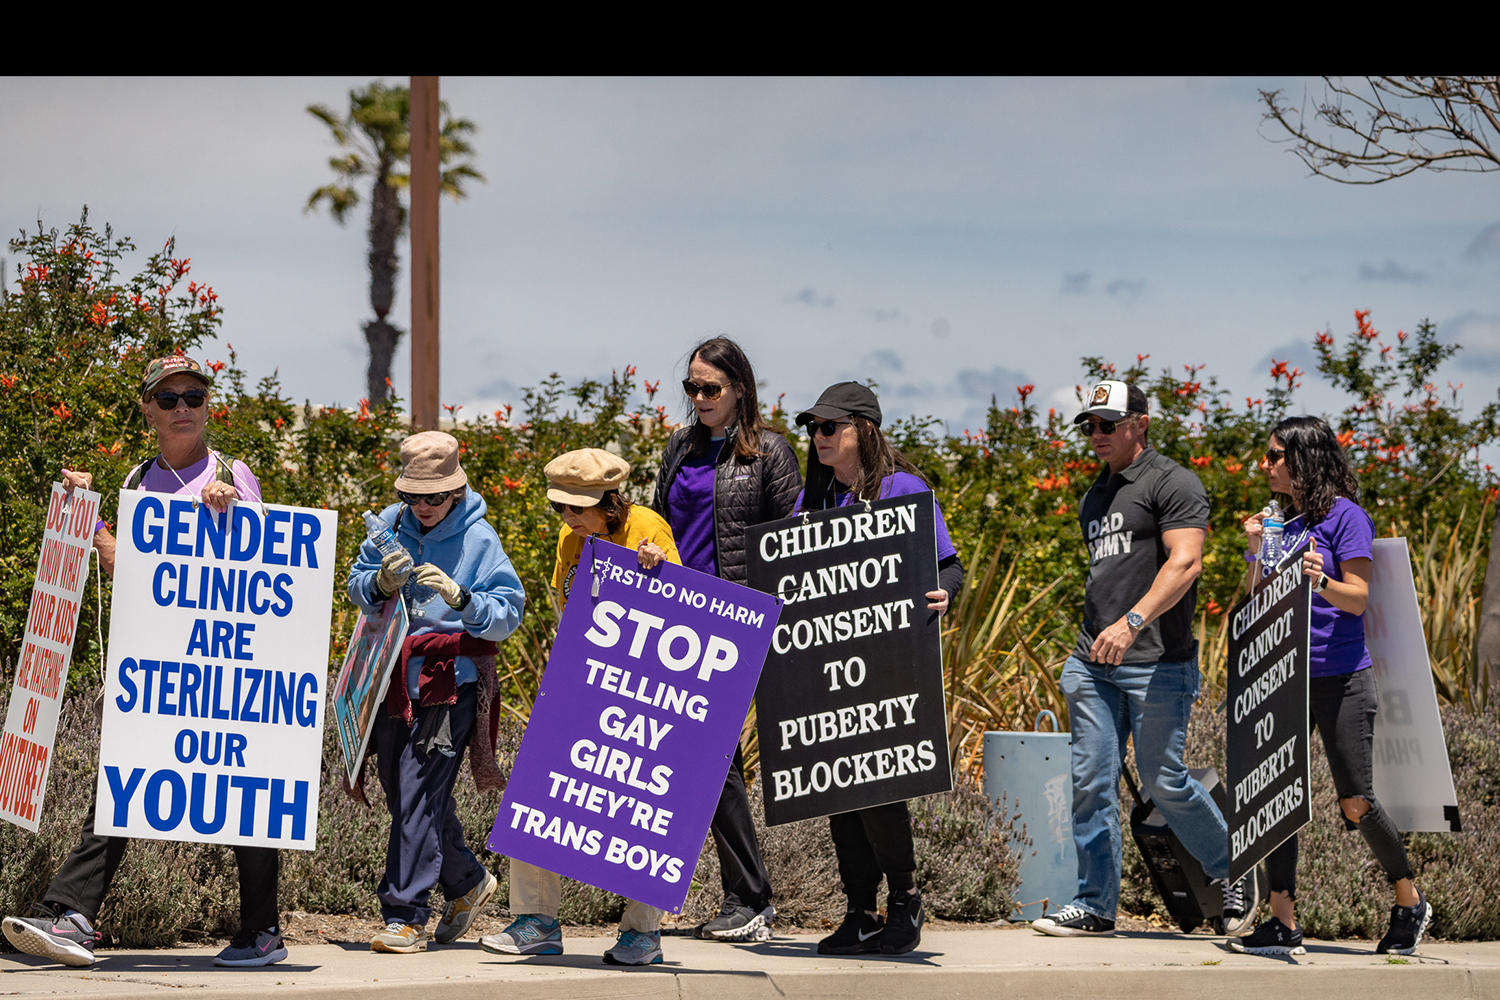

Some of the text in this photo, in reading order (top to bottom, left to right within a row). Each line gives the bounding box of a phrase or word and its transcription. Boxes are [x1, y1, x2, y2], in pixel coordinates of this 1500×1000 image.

[47, 491, 96, 541] DO YOU
[131, 496, 321, 569] GENDER
[759, 504, 917, 562] CHILDREN
[1088, 512, 1124, 539] DAD
[38, 538, 85, 592] KNOW WHAT
[1088, 531, 1133, 565] ARMY
[152, 562, 294, 617] CLINICS
[648, 577, 676, 598] DO
[678, 587, 707, 609] NO
[709, 598, 765, 628] HARM
[777, 553, 903, 605] CANNOT
[1232, 557, 1303, 641] CHILDREN
[28, 589, 77, 647] YOUR KIDS
[186, 618, 256, 661] ARE
[584, 600, 739, 682] STOP
[772, 599, 914, 655] CONSENT
[1238, 607, 1294, 678] CANNOT
[16, 642, 65, 701] ARE WATCHING
[115, 657, 318, 728] STERILIZING
[586, 657, 709, 722] TELLING
[823, 656, 867, 691] TO
[1234, 647, 1297, 724] CONSENT
[23, 697, 40, 735] ON
[599, 706, 674, 751] GAY
[779, 693, 919, 750] PUBERTY
[1255, 712, 1274, 749] TO
[174, 729, 248, 767] OUR
[570, 739, 674, 796] GIRLS
[772, 740, 937, 801] BLOCKERS
[1234, 735, 1297, 813] PUBERTY
[103, 765, 309, 840] YOUTH
[1231, 777, 1303, 861] BLOCKERS
[510, 802, 685, 883] TRANS BOYS
